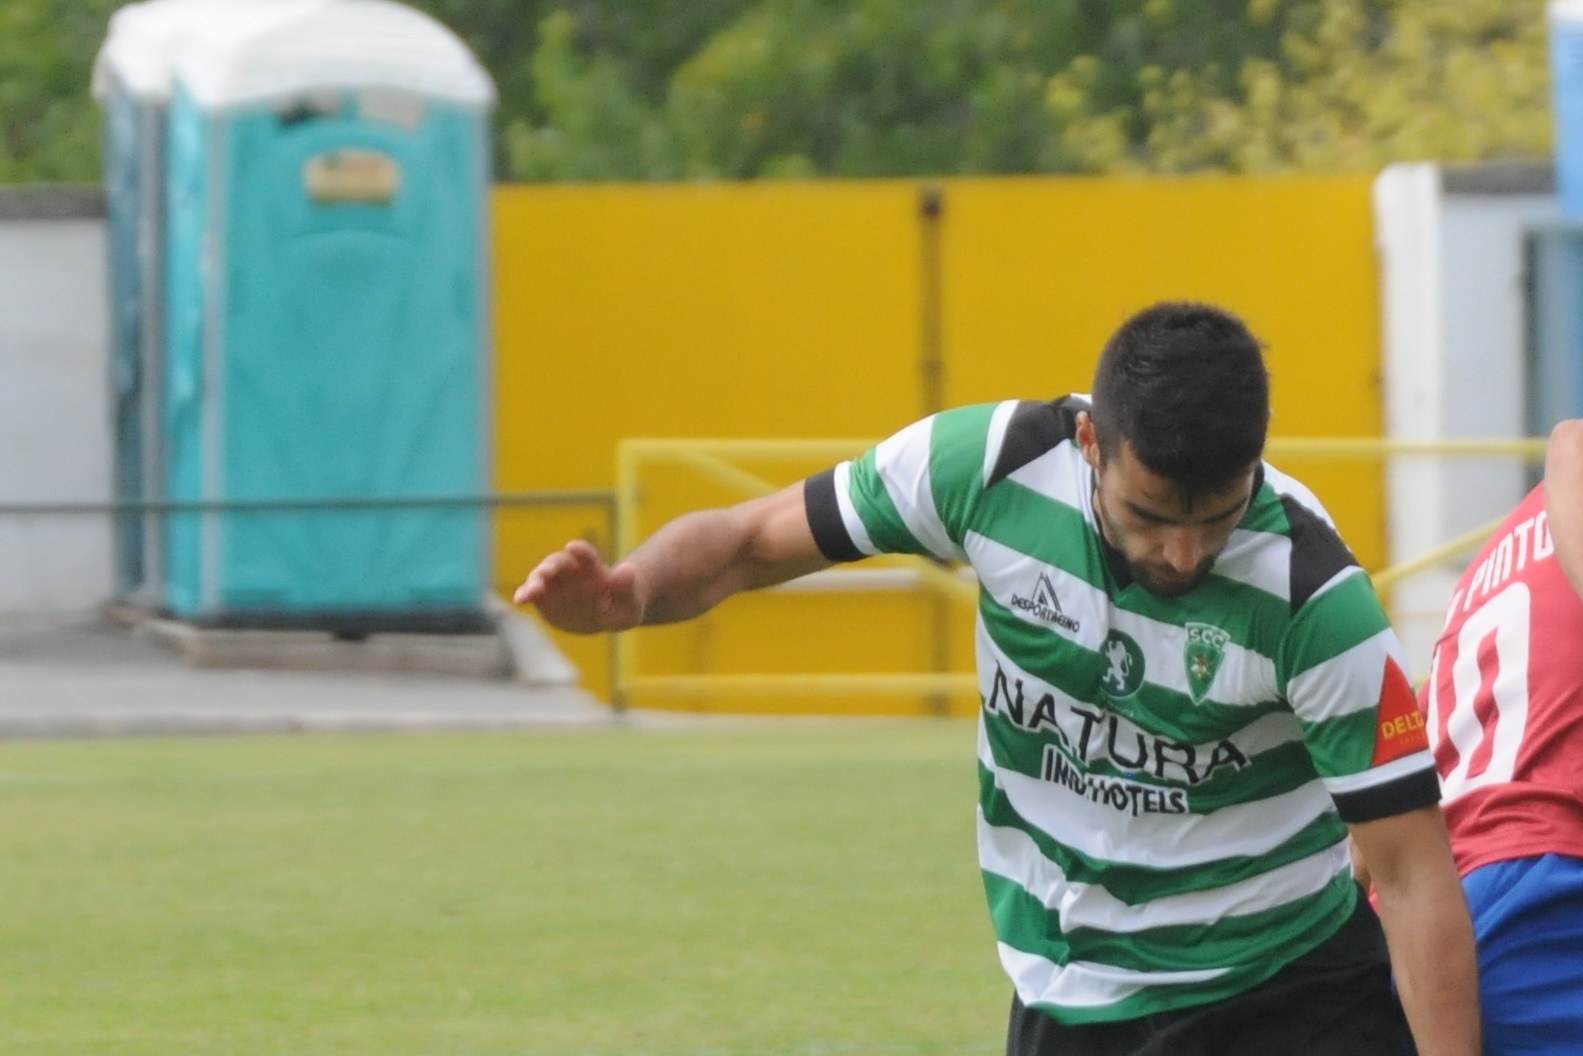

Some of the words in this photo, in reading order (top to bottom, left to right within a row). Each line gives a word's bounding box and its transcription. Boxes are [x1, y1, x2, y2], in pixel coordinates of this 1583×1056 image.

[1190, 628, 1223, 649] SCC
[988, 660, 1248, 785] NATURA
[1381, 710, 1425, 739] DELT
[1088, 777, 1186, 817] HOTELS
